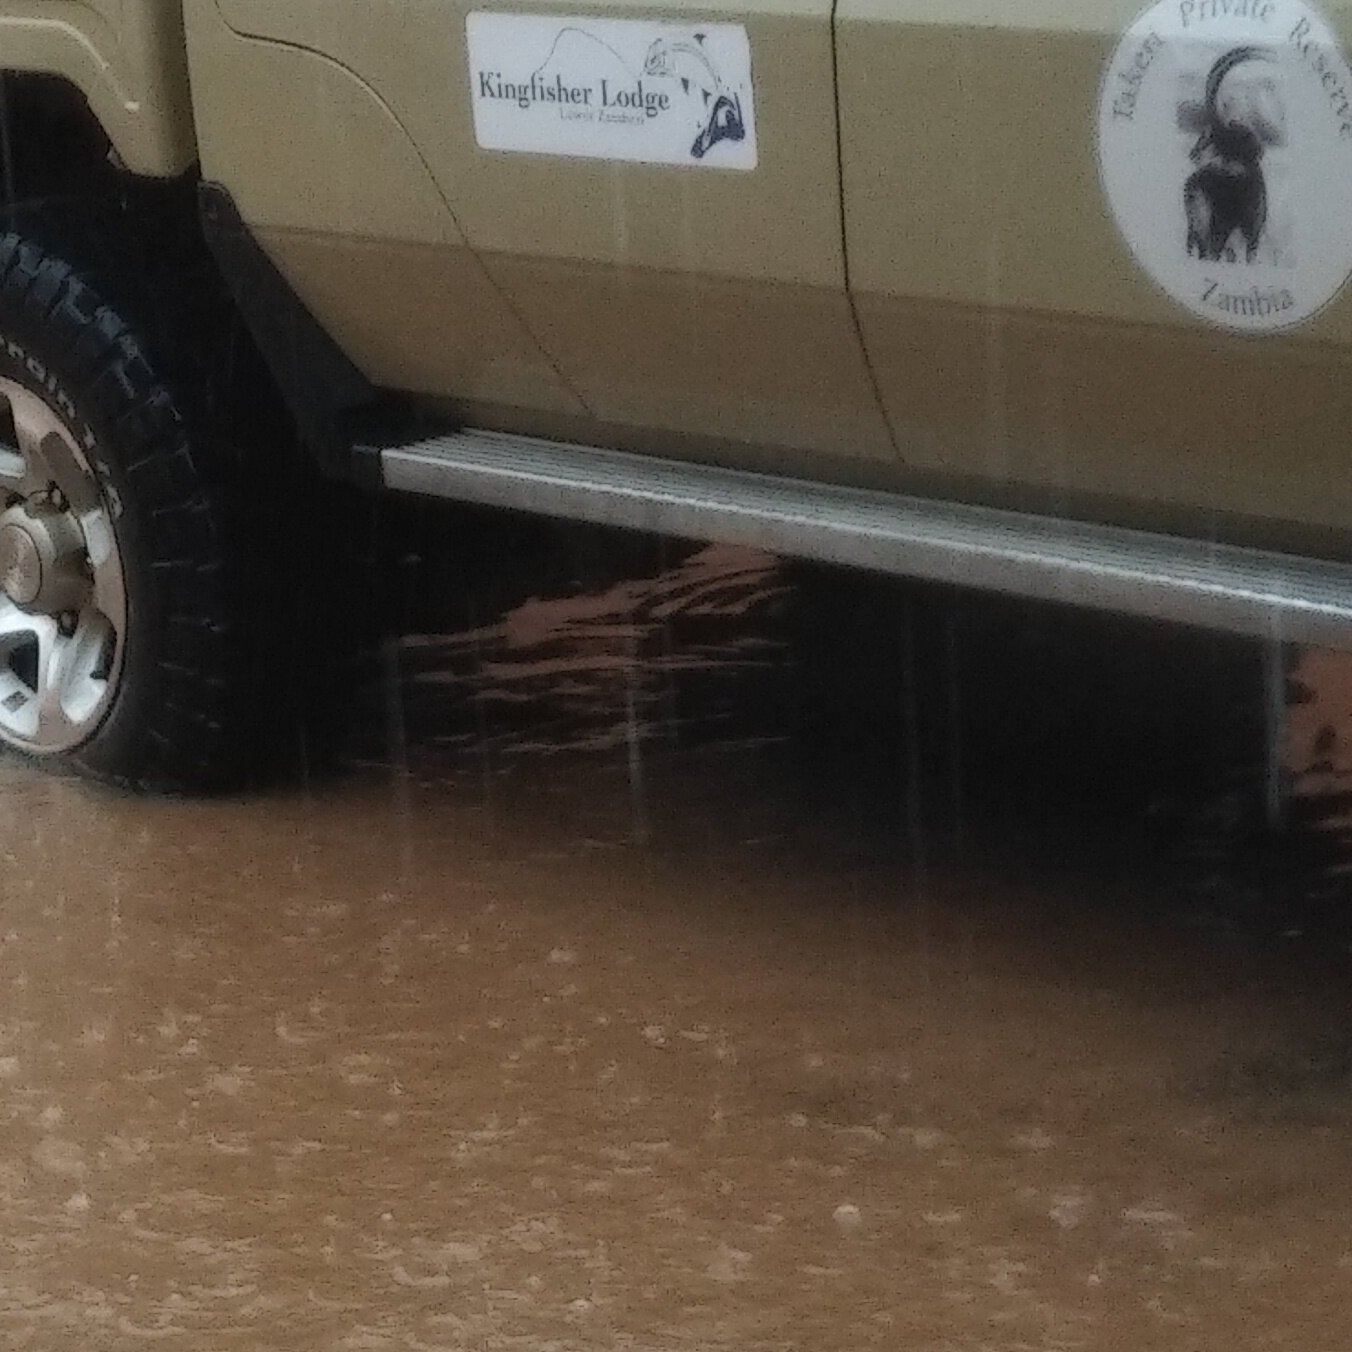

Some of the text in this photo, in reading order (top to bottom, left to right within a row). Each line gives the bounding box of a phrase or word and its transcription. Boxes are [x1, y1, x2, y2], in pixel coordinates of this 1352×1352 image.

[479, 71, 593, 109] Kingfisher
[601, 78, 670, 118] Lodge
[1202, 277, 1294, 316] Zambia
